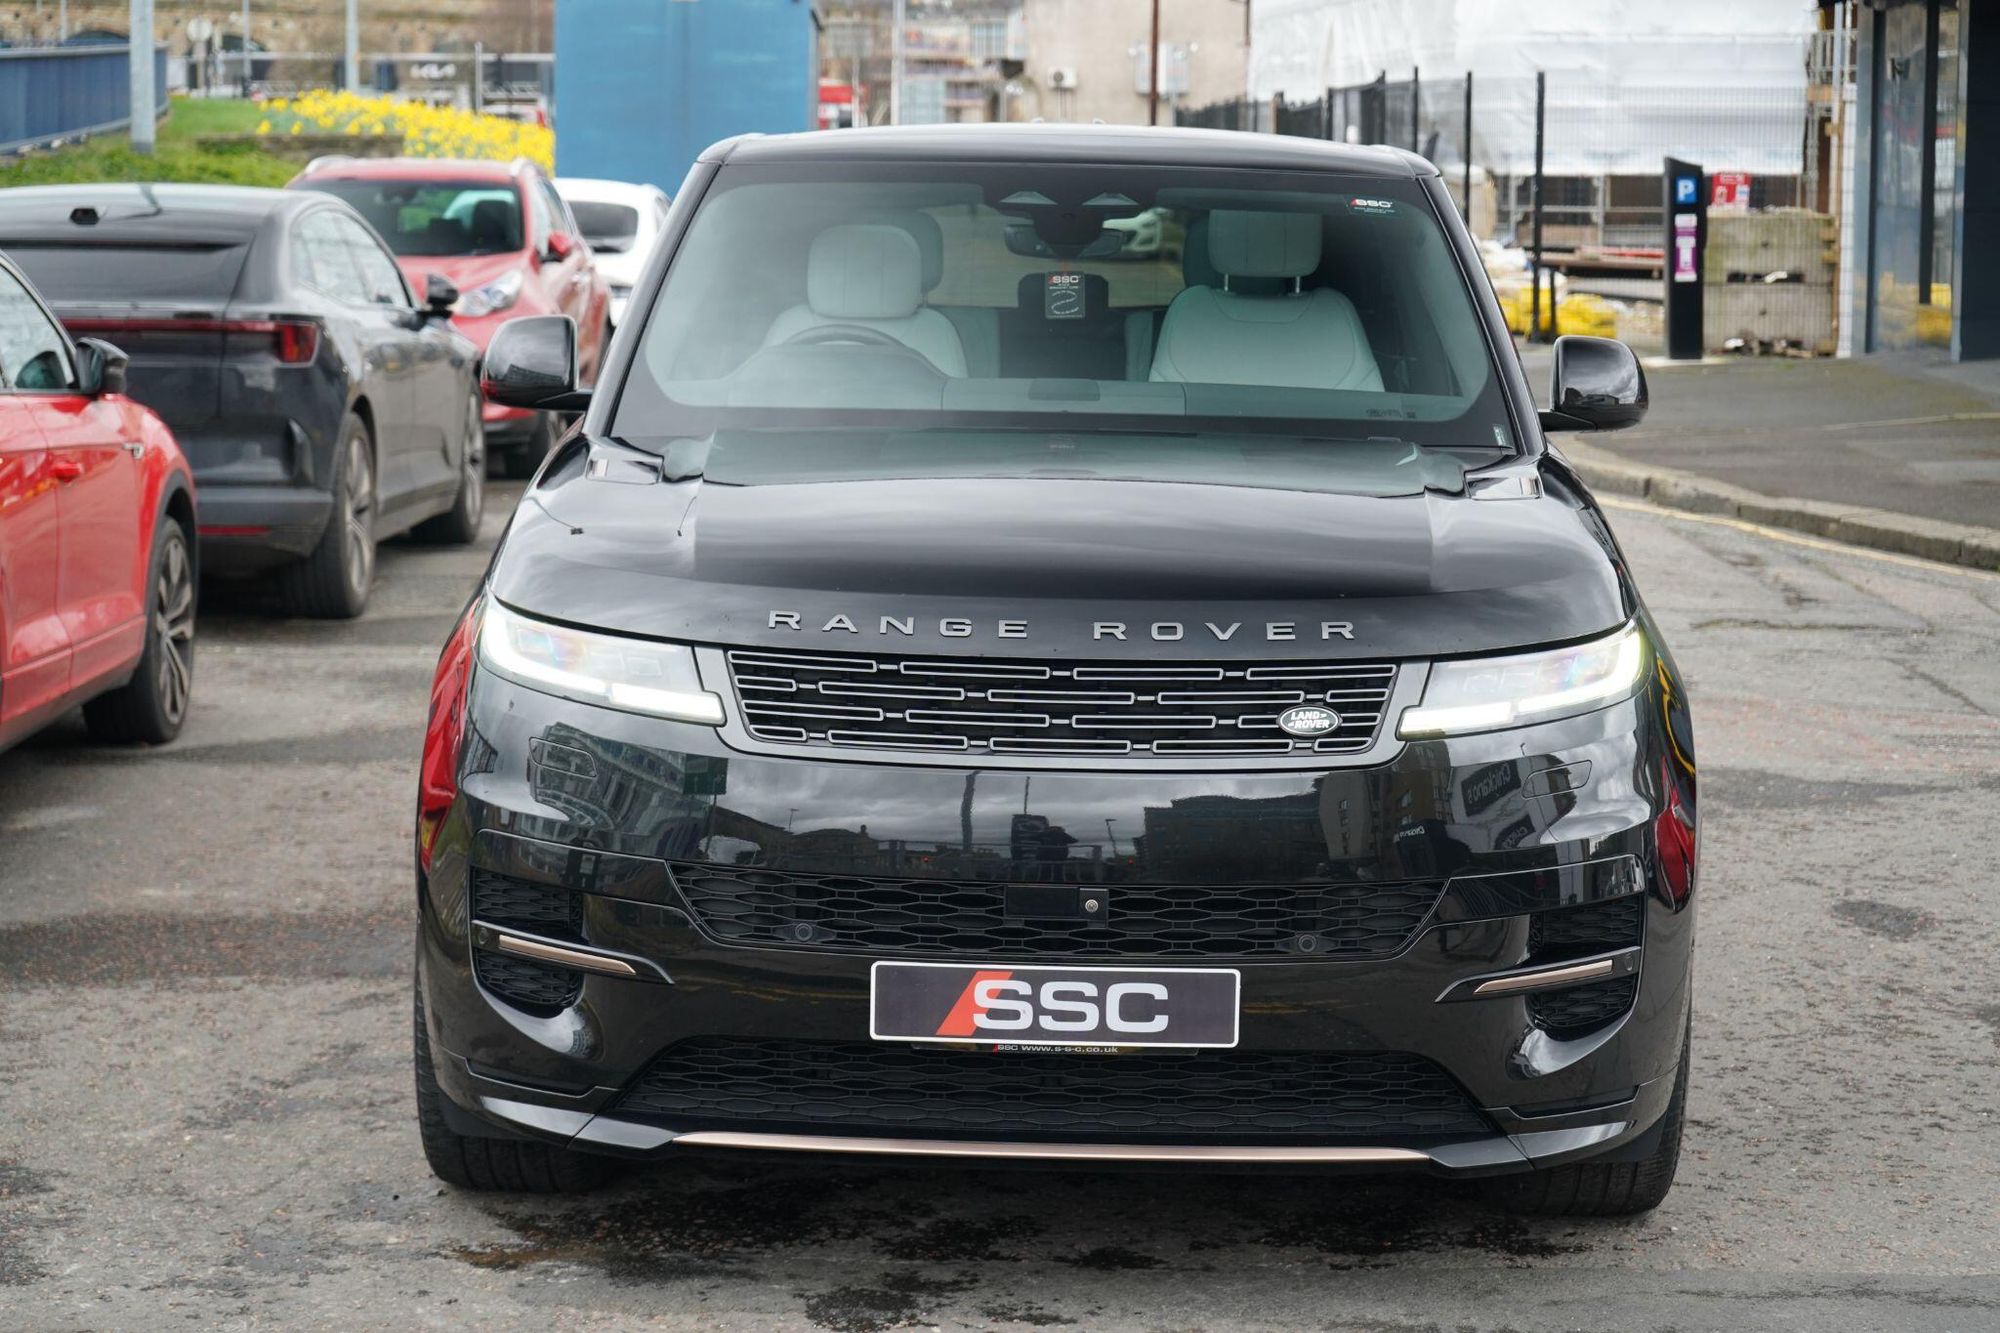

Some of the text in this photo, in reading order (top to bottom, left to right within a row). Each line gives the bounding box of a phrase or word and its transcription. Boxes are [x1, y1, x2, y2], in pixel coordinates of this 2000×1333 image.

[1678, 179, 1695, 201] P
[1356, 199, 1391, 207] SSC
[1053, 275, 1079, 283] SSC
[768, 610, 1355, 641] RANGE ROVER
[1291, 711, 1320, 720] LAND
[1294, 720, 1330, 729] ROVER
[973, 980, 1169, 1033] SSC
[1022, 1045, 1118, 1053] www.s-s-c.co.uk
